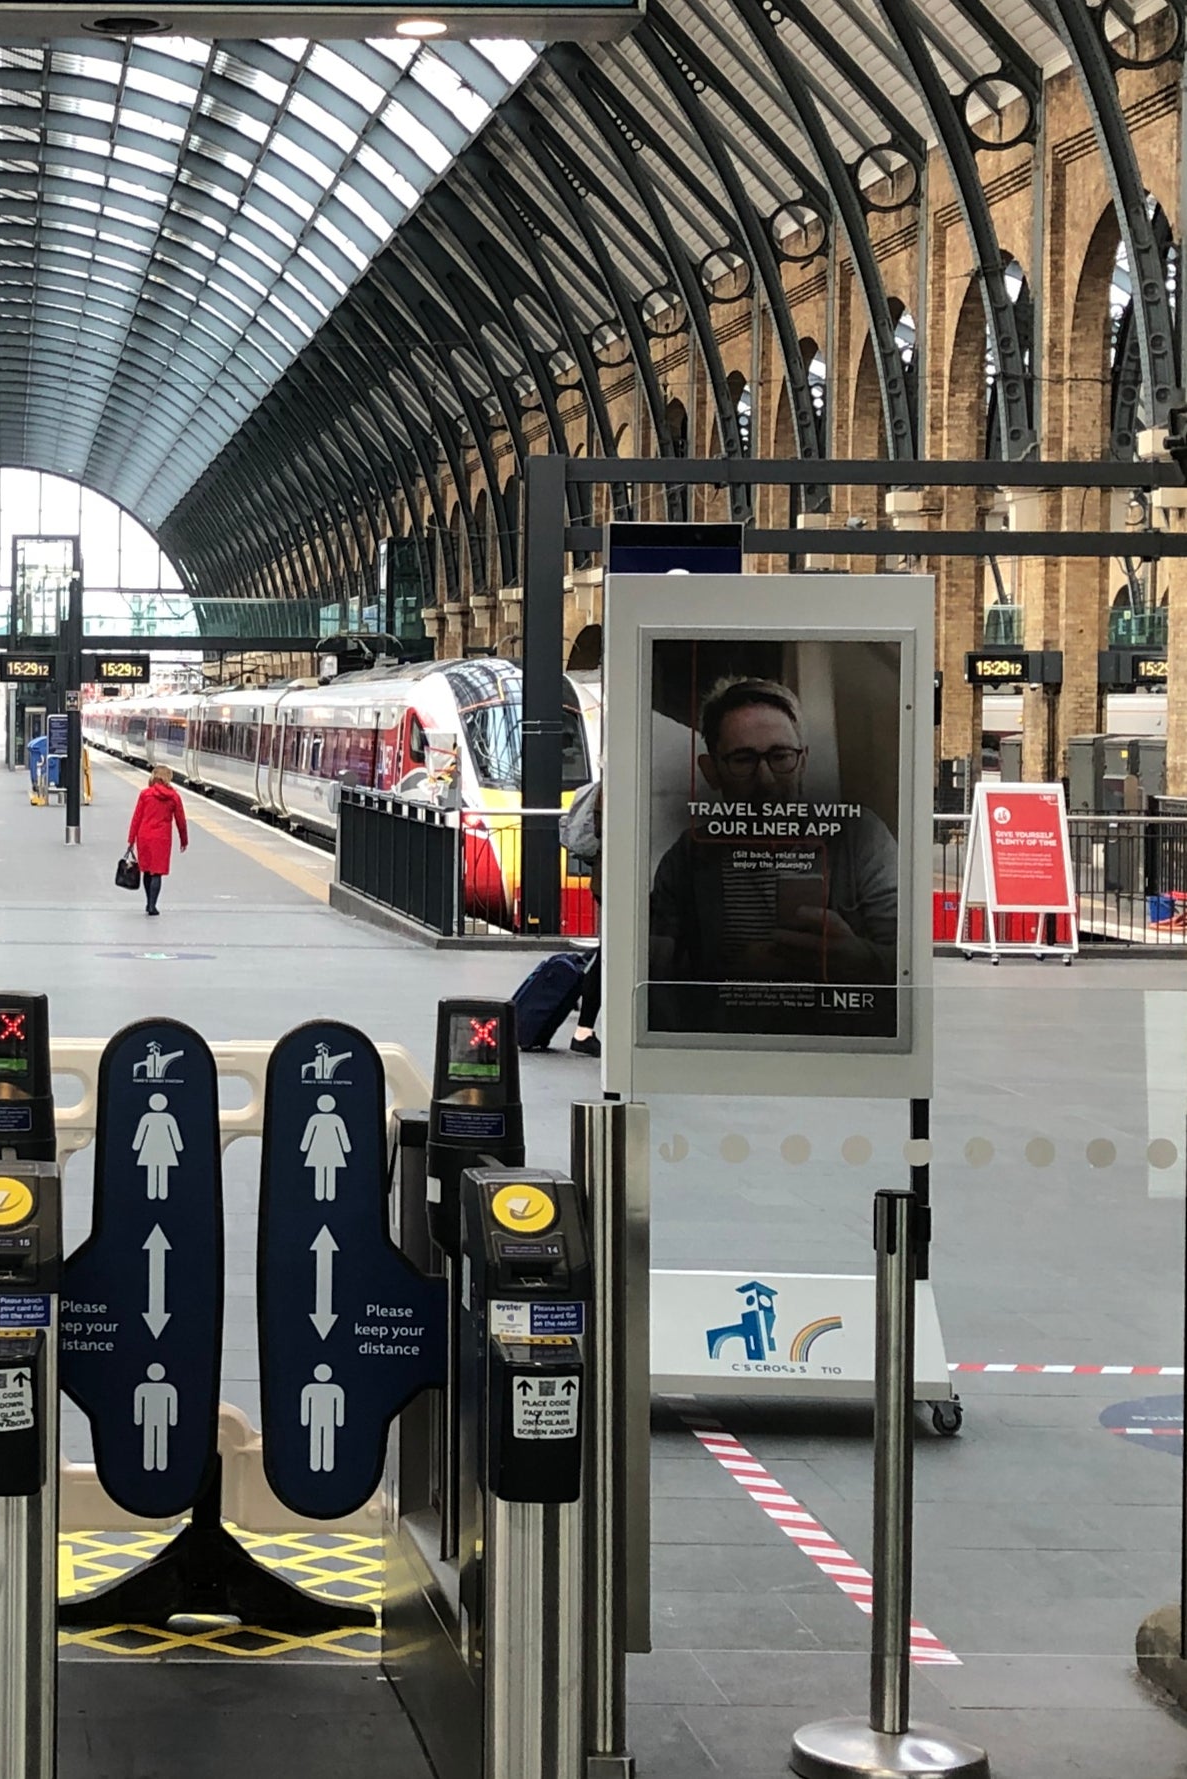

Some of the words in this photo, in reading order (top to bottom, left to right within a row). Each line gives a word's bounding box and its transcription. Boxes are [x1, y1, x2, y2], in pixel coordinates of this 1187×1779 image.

[687, 801, 758, 816] TRAVEL
[763, 802, 808, 817] SAFE
[813, 803, 861, 818] WITH
[707, 821, 748, 835] OUR
[752, 821, 800, 836] LNER
[805, 822, 841, 836] APP
[995, 830, 1014, 838] GIVE
[1015, 831, 1054, 839] YOURSELF
[996, 838, 1025, 846] PLENTY
[1026, 838, 1037, 846] OF
[1038, 839, 1057, 847] TIME
[732, 850, 748, 860] (Sit
[750, 850, 774, 860] back,
[798, 851, 816, 860] and
[733, 860, 757, 870] enjoy
[759, 860, 774, 869] the
[775, 861, 812, 871] journey)
[820, 990, 875, 1010] LNER
[547, 1246, 559, 1254] 14
[0, 1297, 23, 1305] Please
[0, 1305, 16, 1313] your
[61, 1300, 108, 1313] Please
[366, 1304, 414, 1317] Please
[496, 1303, 523, 1311] oyster
[533, 1304, 556, 1312] Please
[556, 1304, 576, 1312] touch
[86, 1322, 119, 1335] your
[354, 1322, 389, 1339] keep
[391, 1326, 425, 1340] your
[63, 1339, 114, 1352] istance
[358, 1341, 420, 1355] distance
[2, 1391, 24, 1399] CODE
[0, 1401, 24, 1409] DOWN
[0, 1410, 26, 1418] GLASS
[549, 1427, 574, 1435] ABOVE
